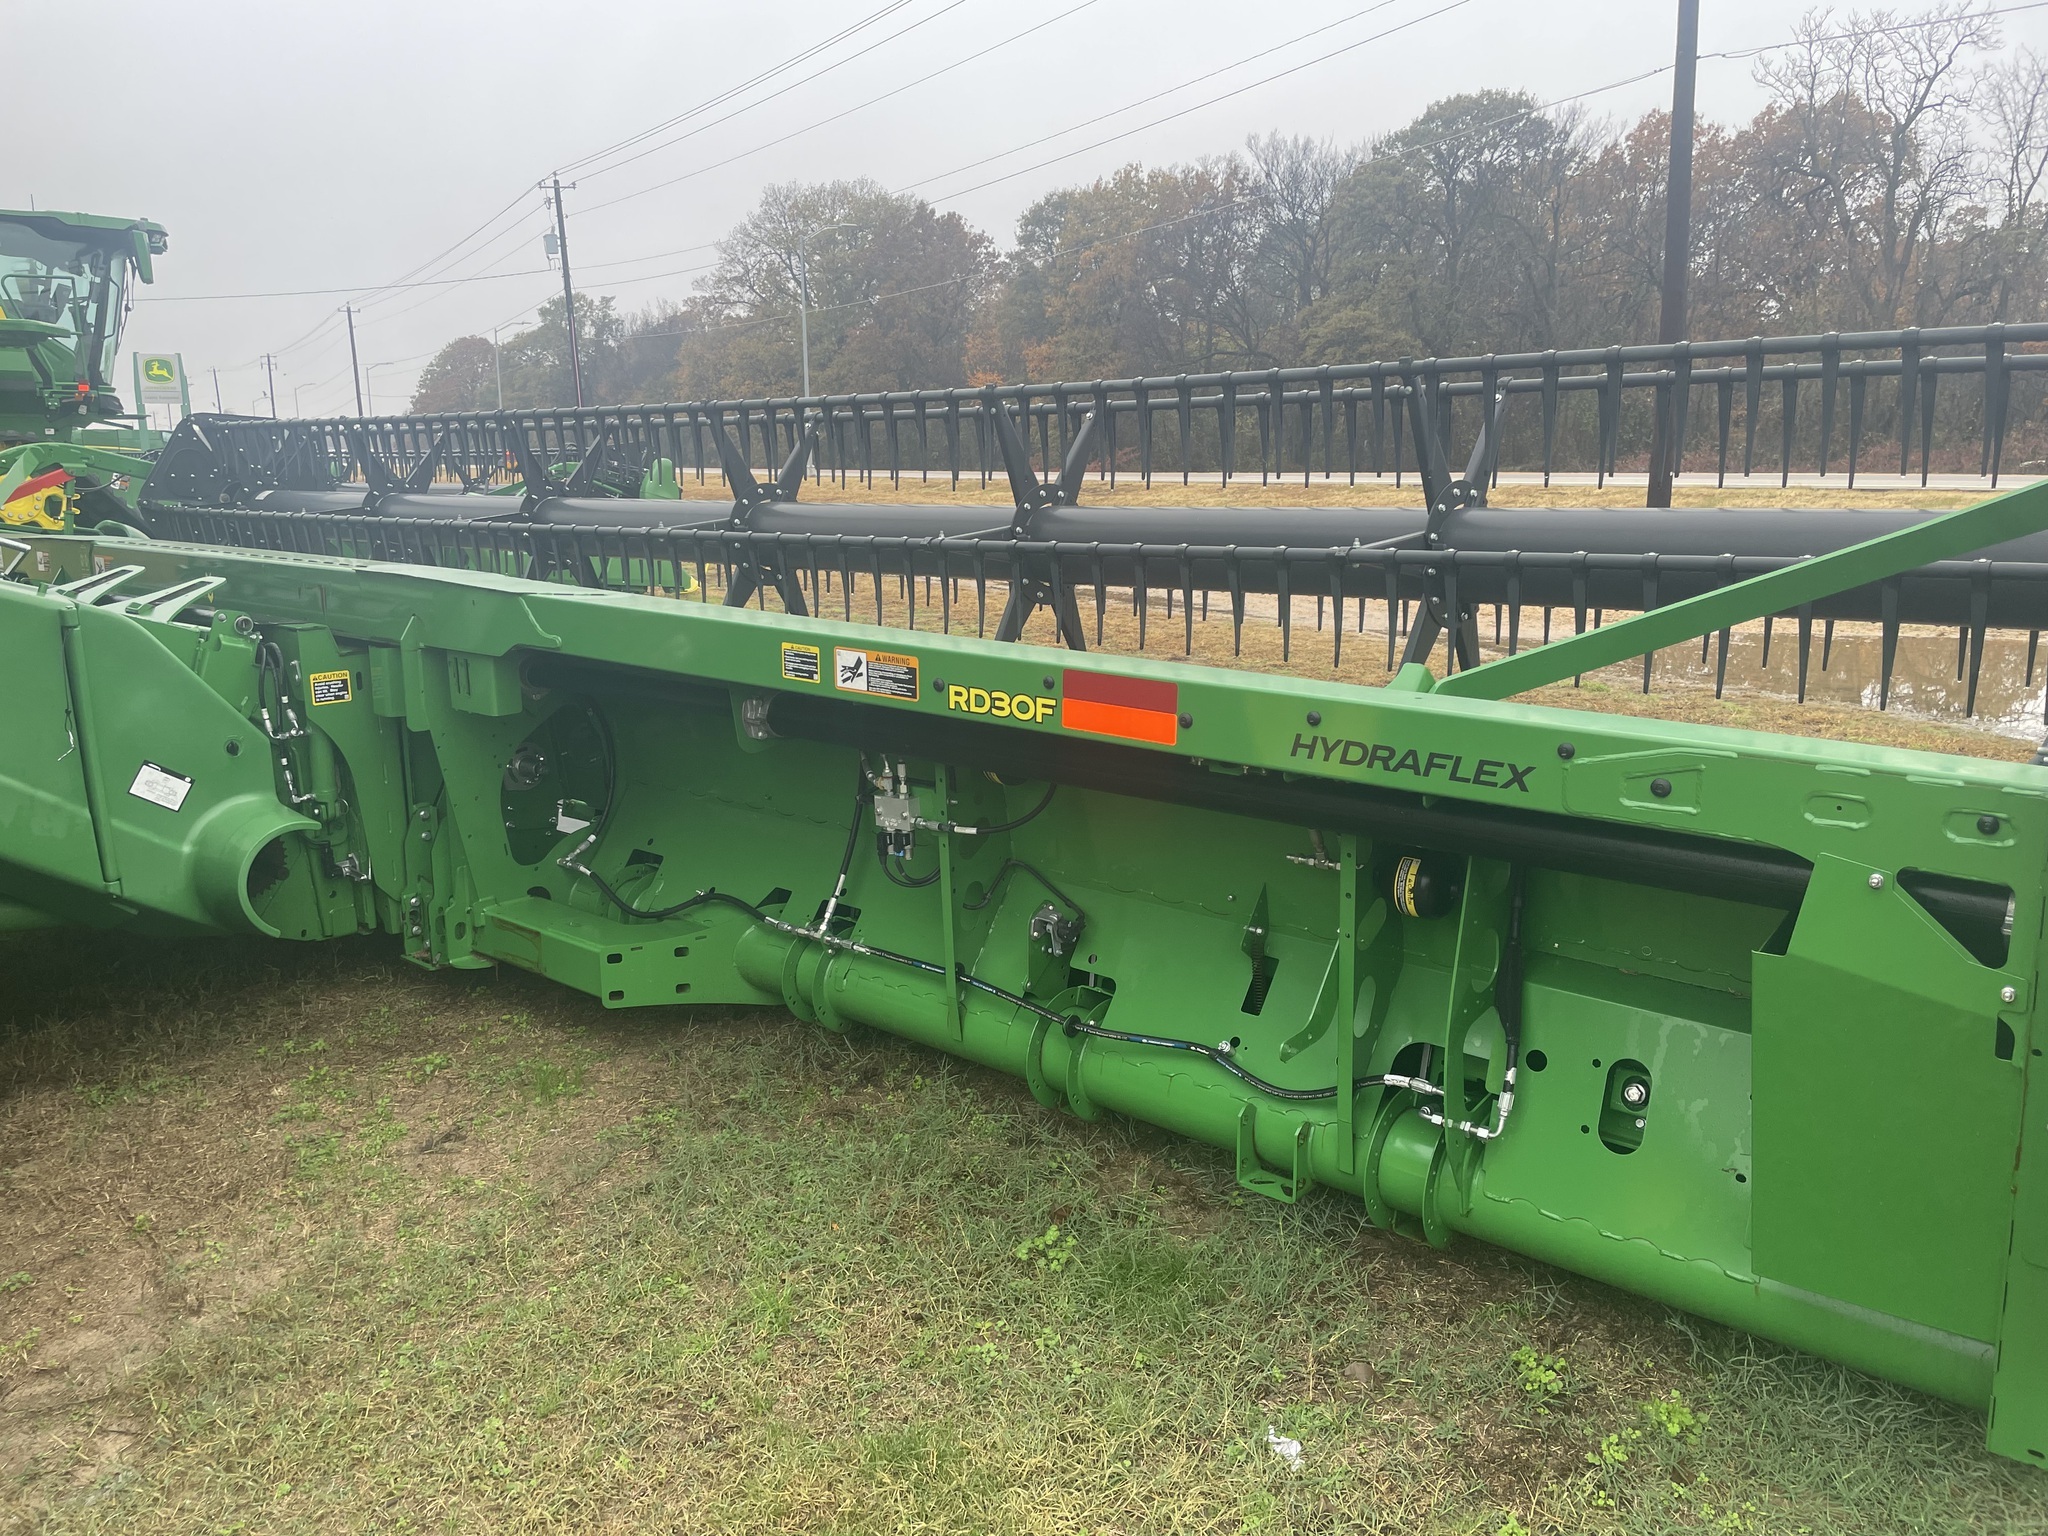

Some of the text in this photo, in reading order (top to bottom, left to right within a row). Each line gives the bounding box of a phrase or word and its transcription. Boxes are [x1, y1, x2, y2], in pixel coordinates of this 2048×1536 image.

[881, 654, 910, 666] WARNING
[317, 672, 348, 680] CAUTION
[948, 684, 1057, 724] RD30F
[1290, 733, 1537, 793] HYDRAFLEX
